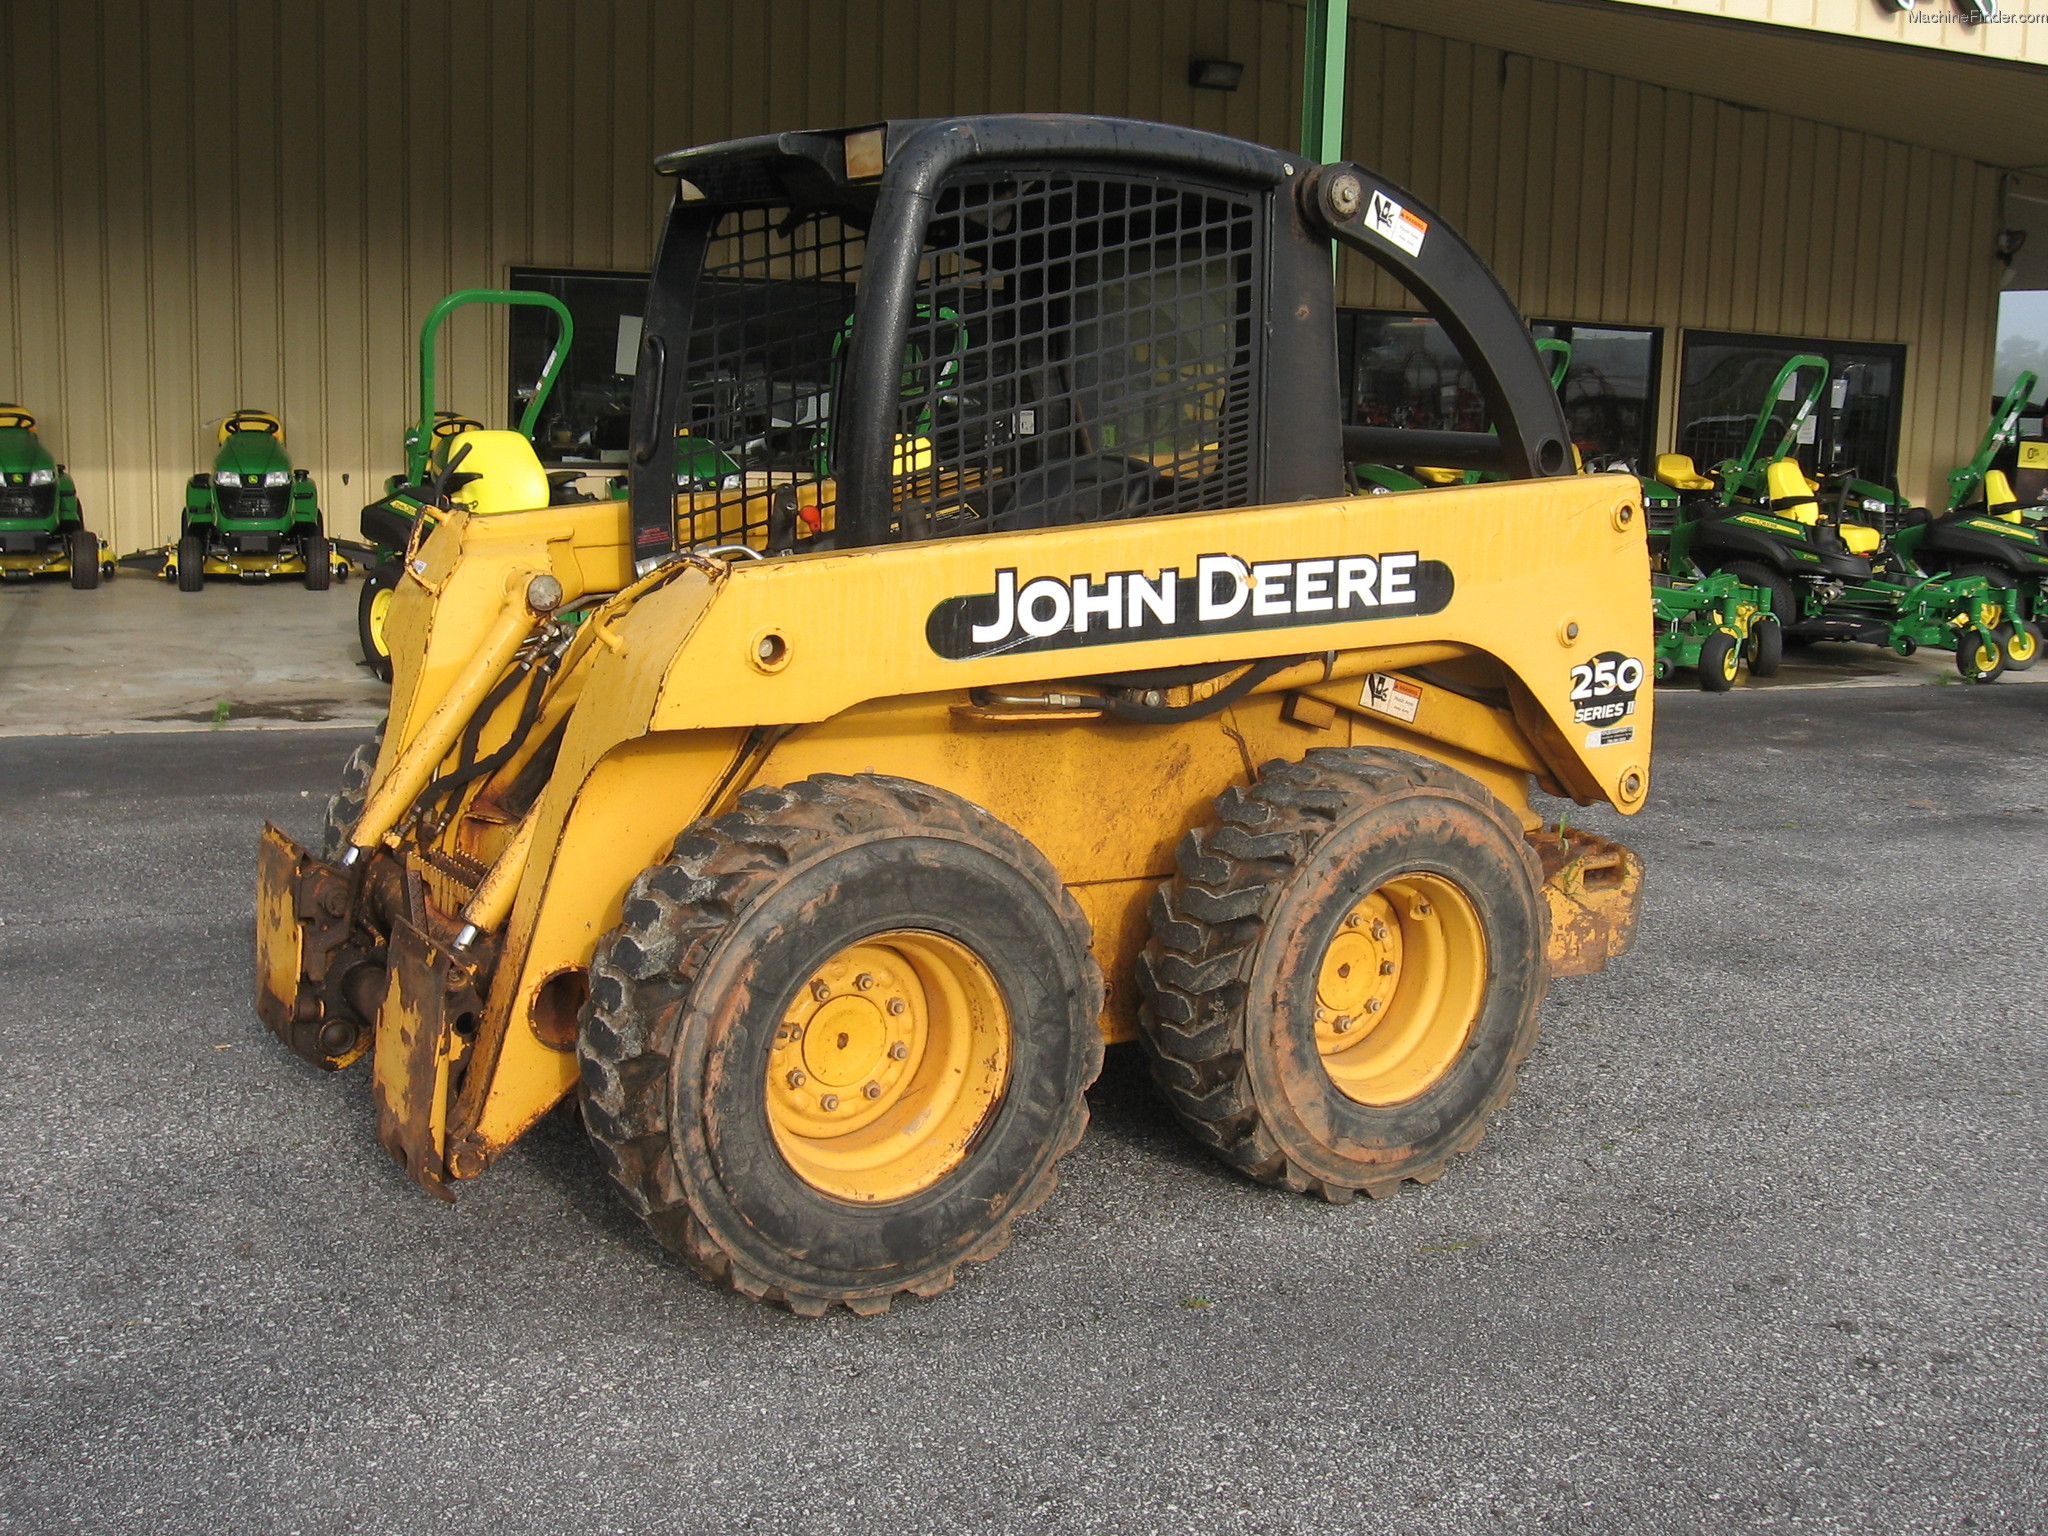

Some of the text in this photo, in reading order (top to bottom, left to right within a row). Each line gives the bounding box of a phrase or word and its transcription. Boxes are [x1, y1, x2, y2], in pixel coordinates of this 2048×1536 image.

[972, 553, 1418, 644] JOHN DEERE
[1570, 658, 1643, 700] 250
[1574, 700, 1636, 723] SERIES II
